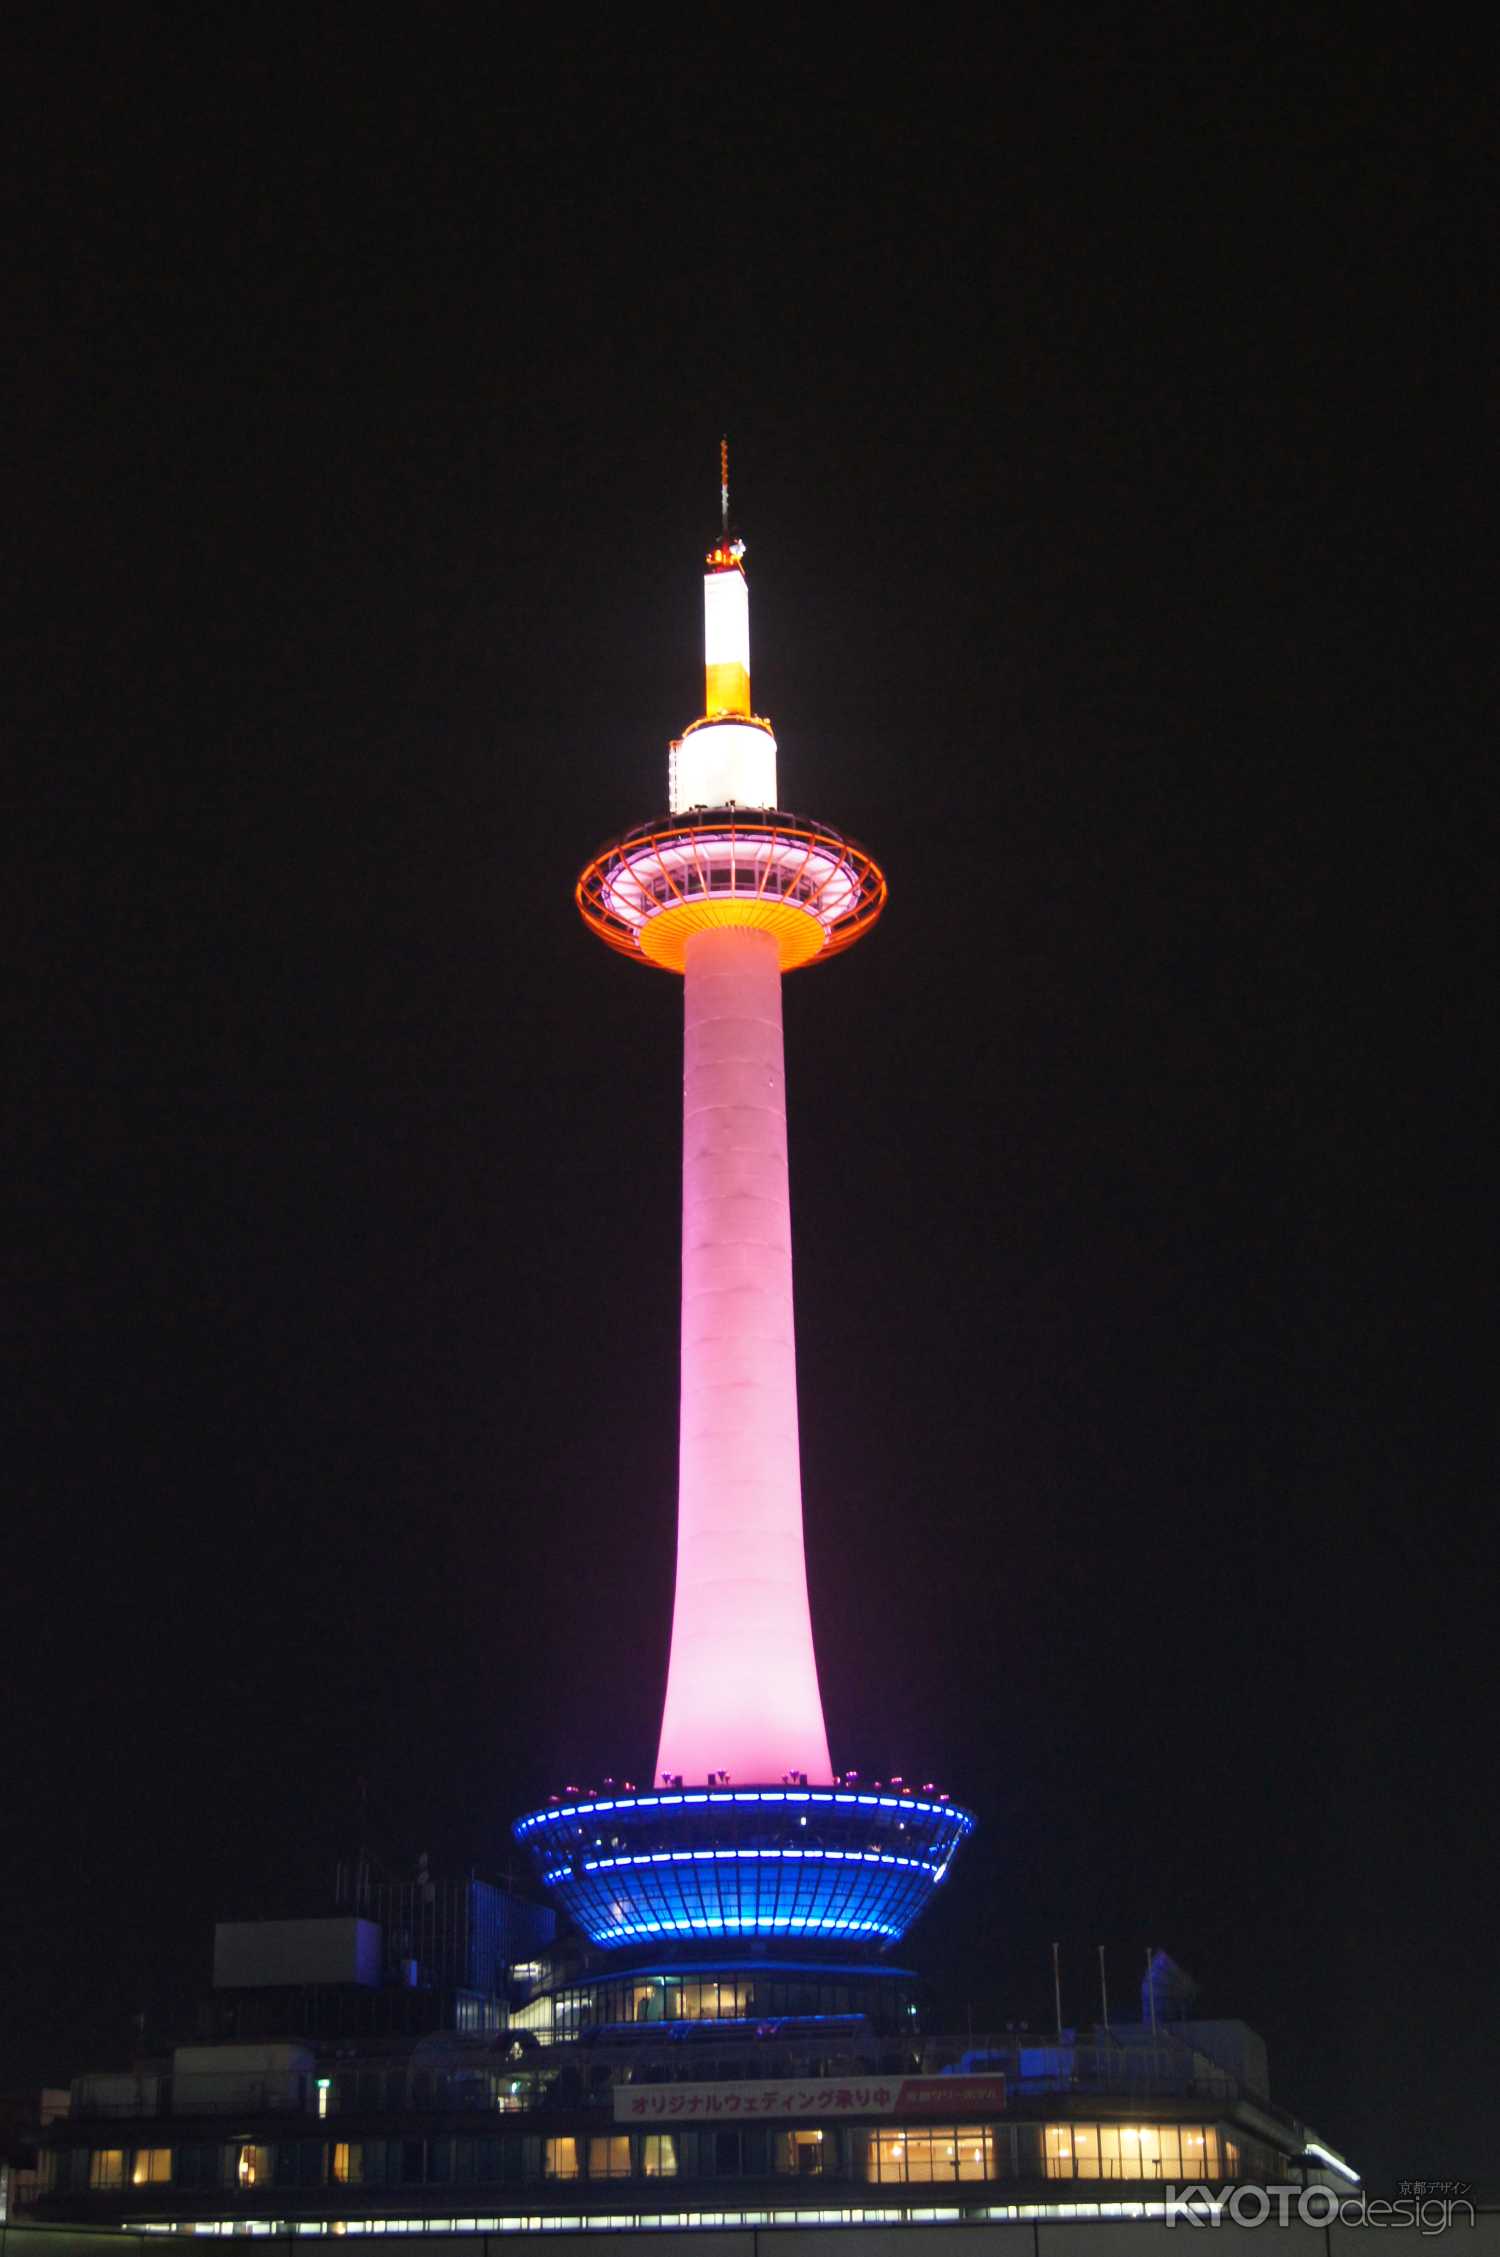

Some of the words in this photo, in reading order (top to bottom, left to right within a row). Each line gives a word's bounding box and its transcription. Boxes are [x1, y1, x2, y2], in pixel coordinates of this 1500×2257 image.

[631, 2087, 891, 2114] オリジナルウェディング承り中
